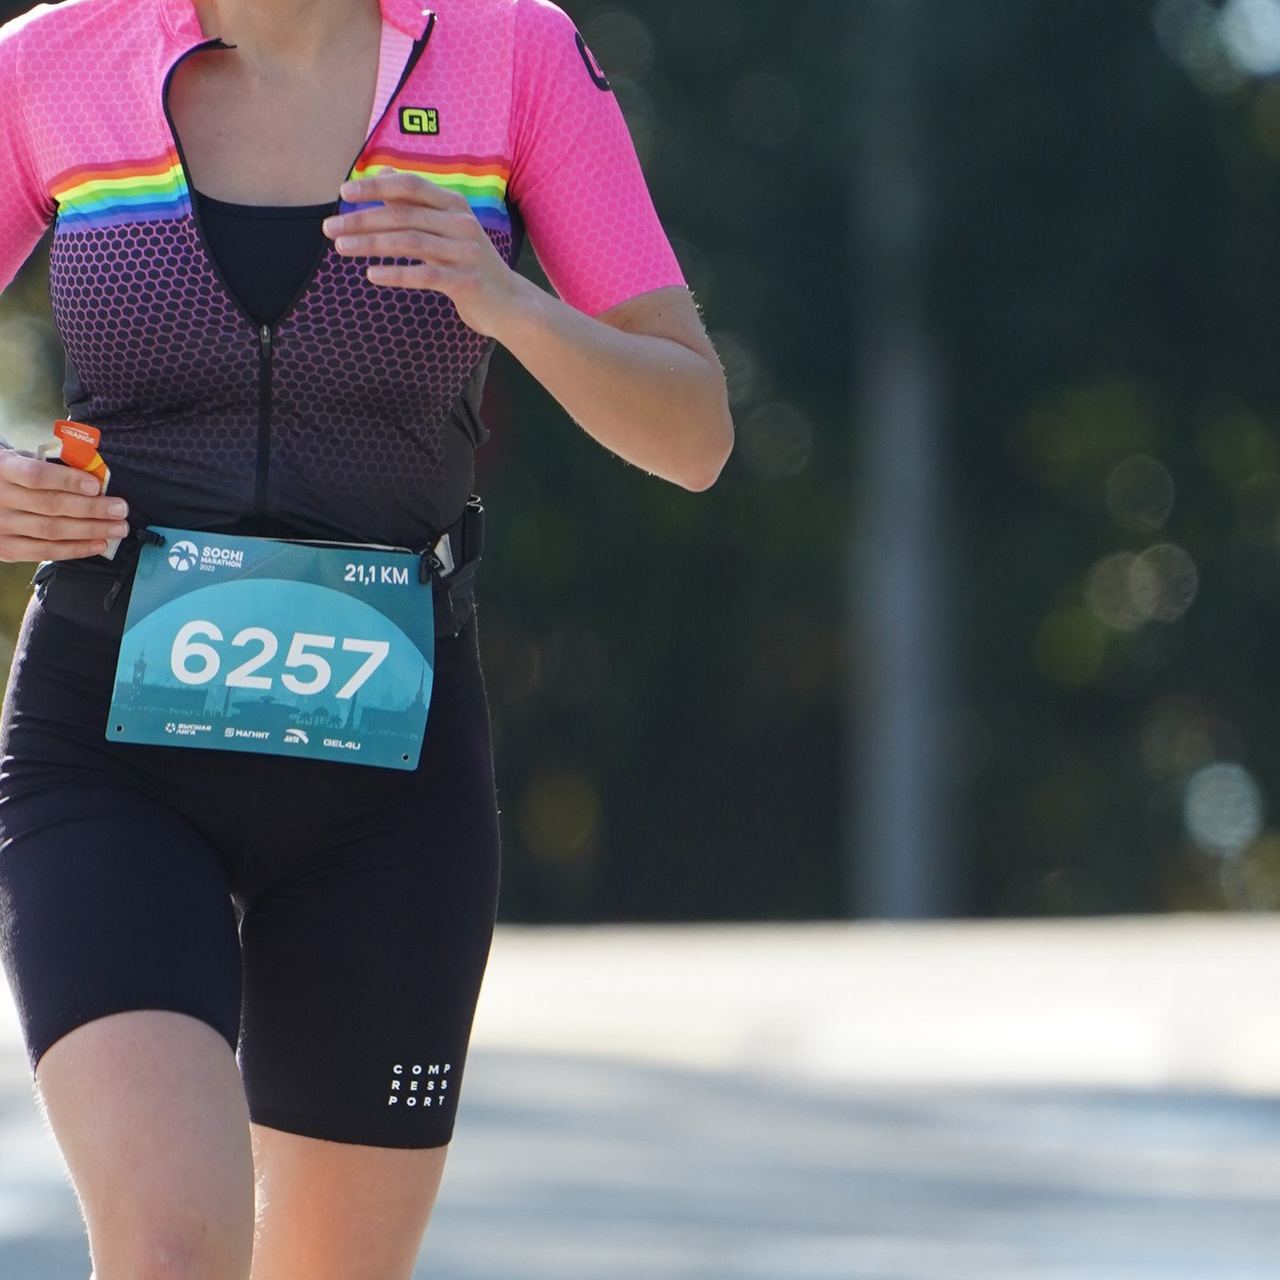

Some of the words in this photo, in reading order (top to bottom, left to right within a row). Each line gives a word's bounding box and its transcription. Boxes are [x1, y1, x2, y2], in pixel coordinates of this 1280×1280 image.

[202, 546, 244, 562] SOCHI
[200, 556, 242, 568] MARATHON
[199, 564, 216, 573] 2022
[344, 563, 376, 586] 21,1
[380, 566, 409, 585] KM
[171, 620, 390, 700] 6257
[235, 729, 271, 740] МАГНИТ
[323, 738, 361, 751] GEL4U
[393, 1063, 451, 1075] COMP
[391, 1080, 448, 1091] RESS
[388, 1095, 445, 1107] PORT
